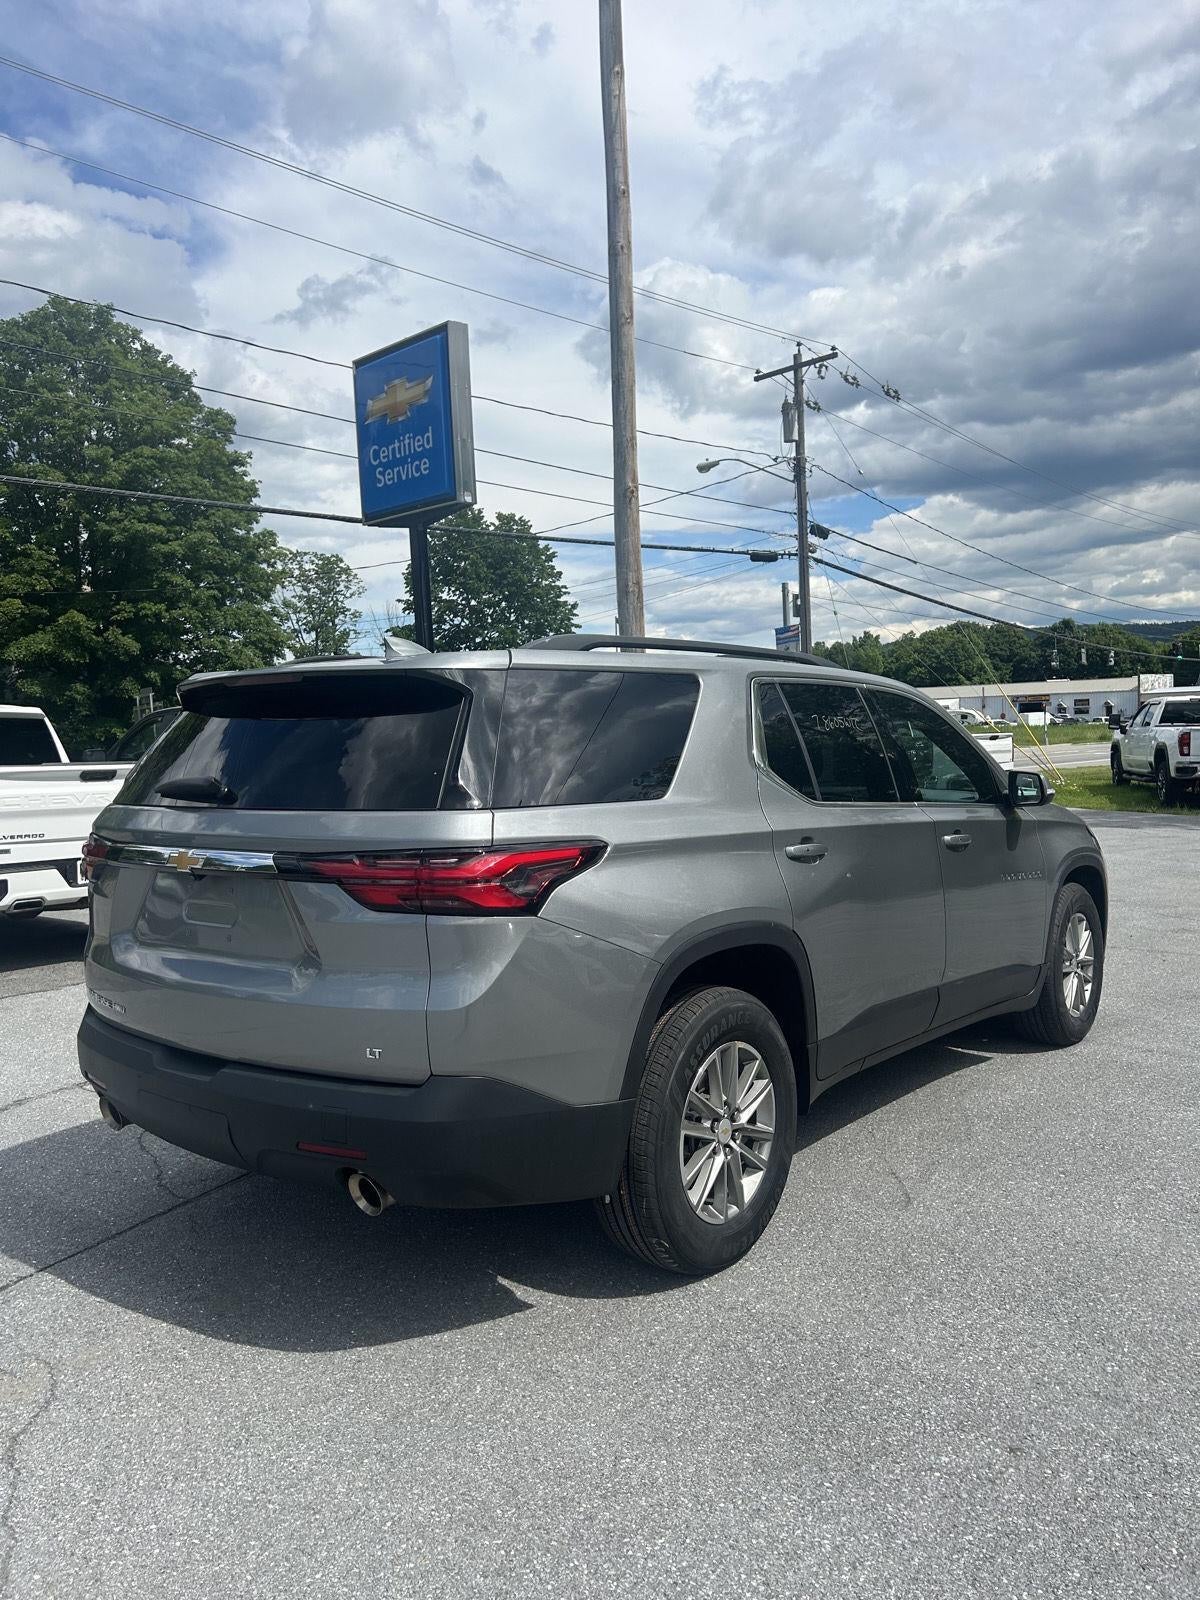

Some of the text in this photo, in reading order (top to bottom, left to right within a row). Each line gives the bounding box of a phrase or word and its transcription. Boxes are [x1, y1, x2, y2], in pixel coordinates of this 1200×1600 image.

[369, 426, 433, 465] Certified
[375, 456, 430, 487] Service
[366, 1048, 383, 1059] LT
